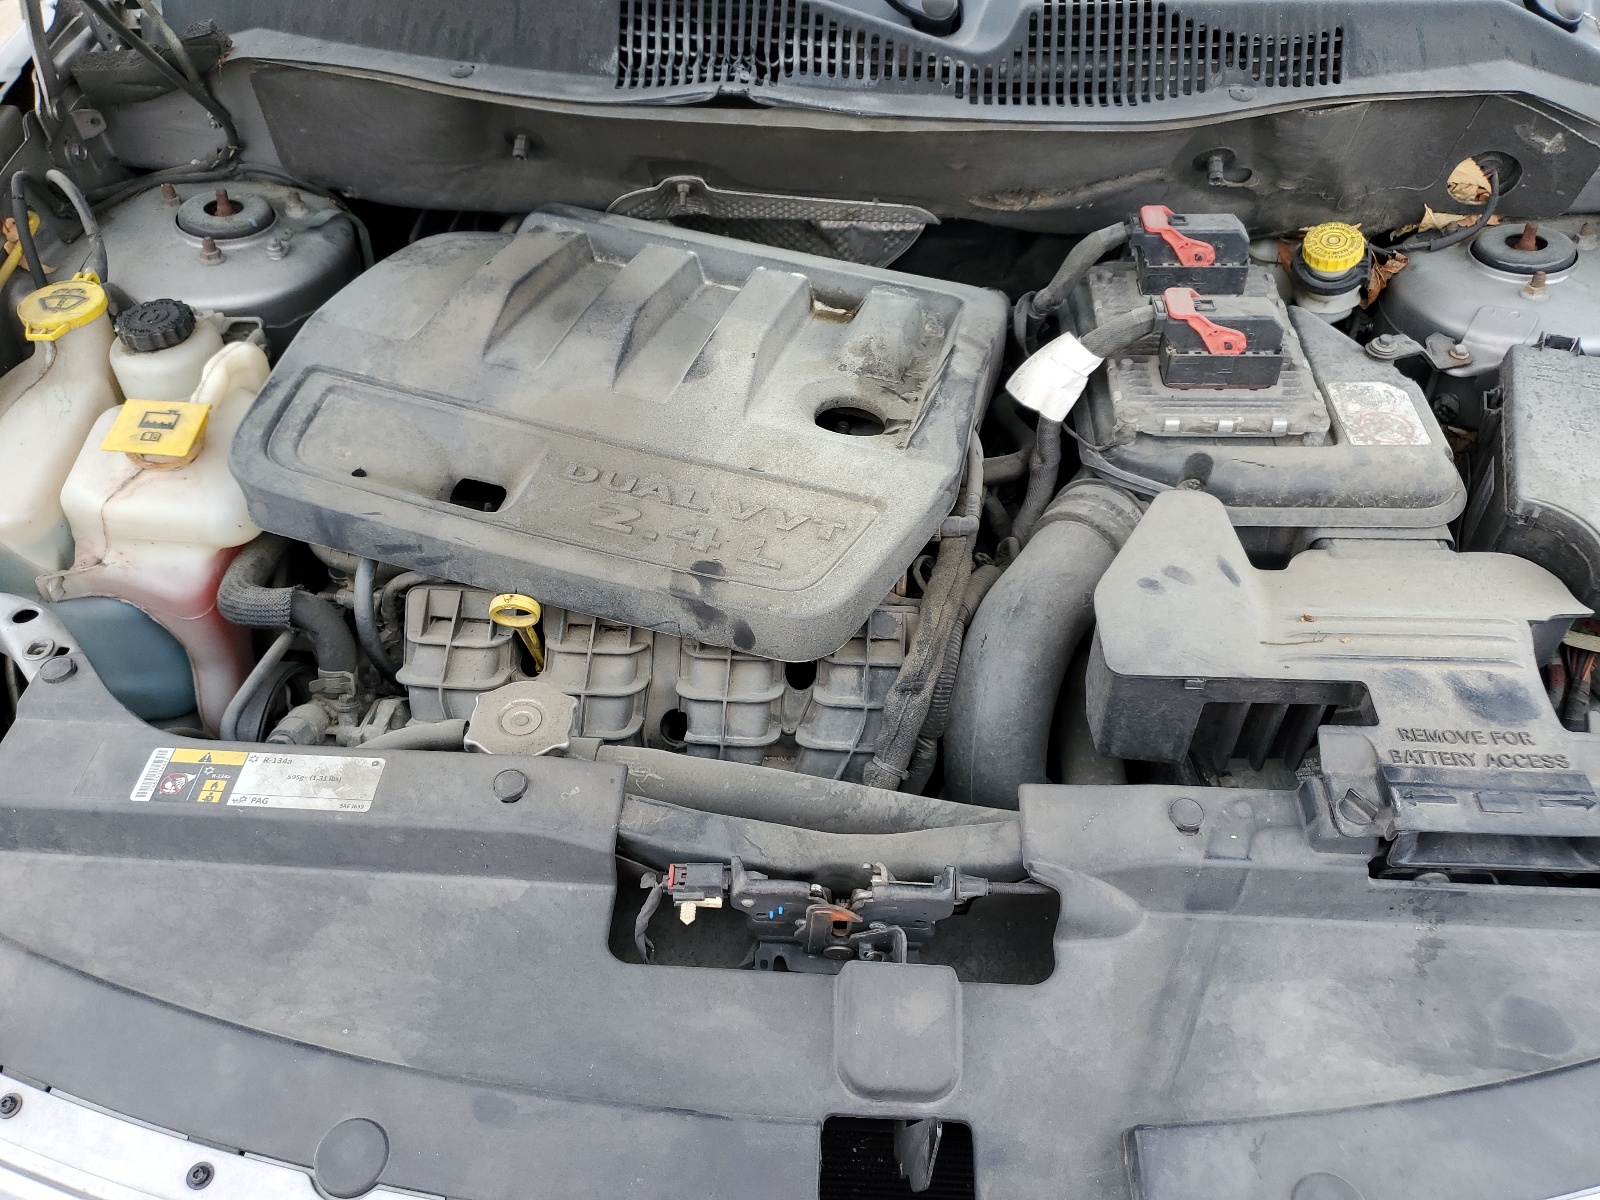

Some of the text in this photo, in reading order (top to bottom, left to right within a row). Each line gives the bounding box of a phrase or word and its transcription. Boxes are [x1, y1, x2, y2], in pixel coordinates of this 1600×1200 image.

[561, 462, 847, 543] DUAL VVT
[1396, 727, 1537, 746] REMOVE FOR
[262, 757, 293, 765] R-134a
[1387, 748, 1571, 769] BATTERY ACCESS
[250, 797, 269, 805] PAG
